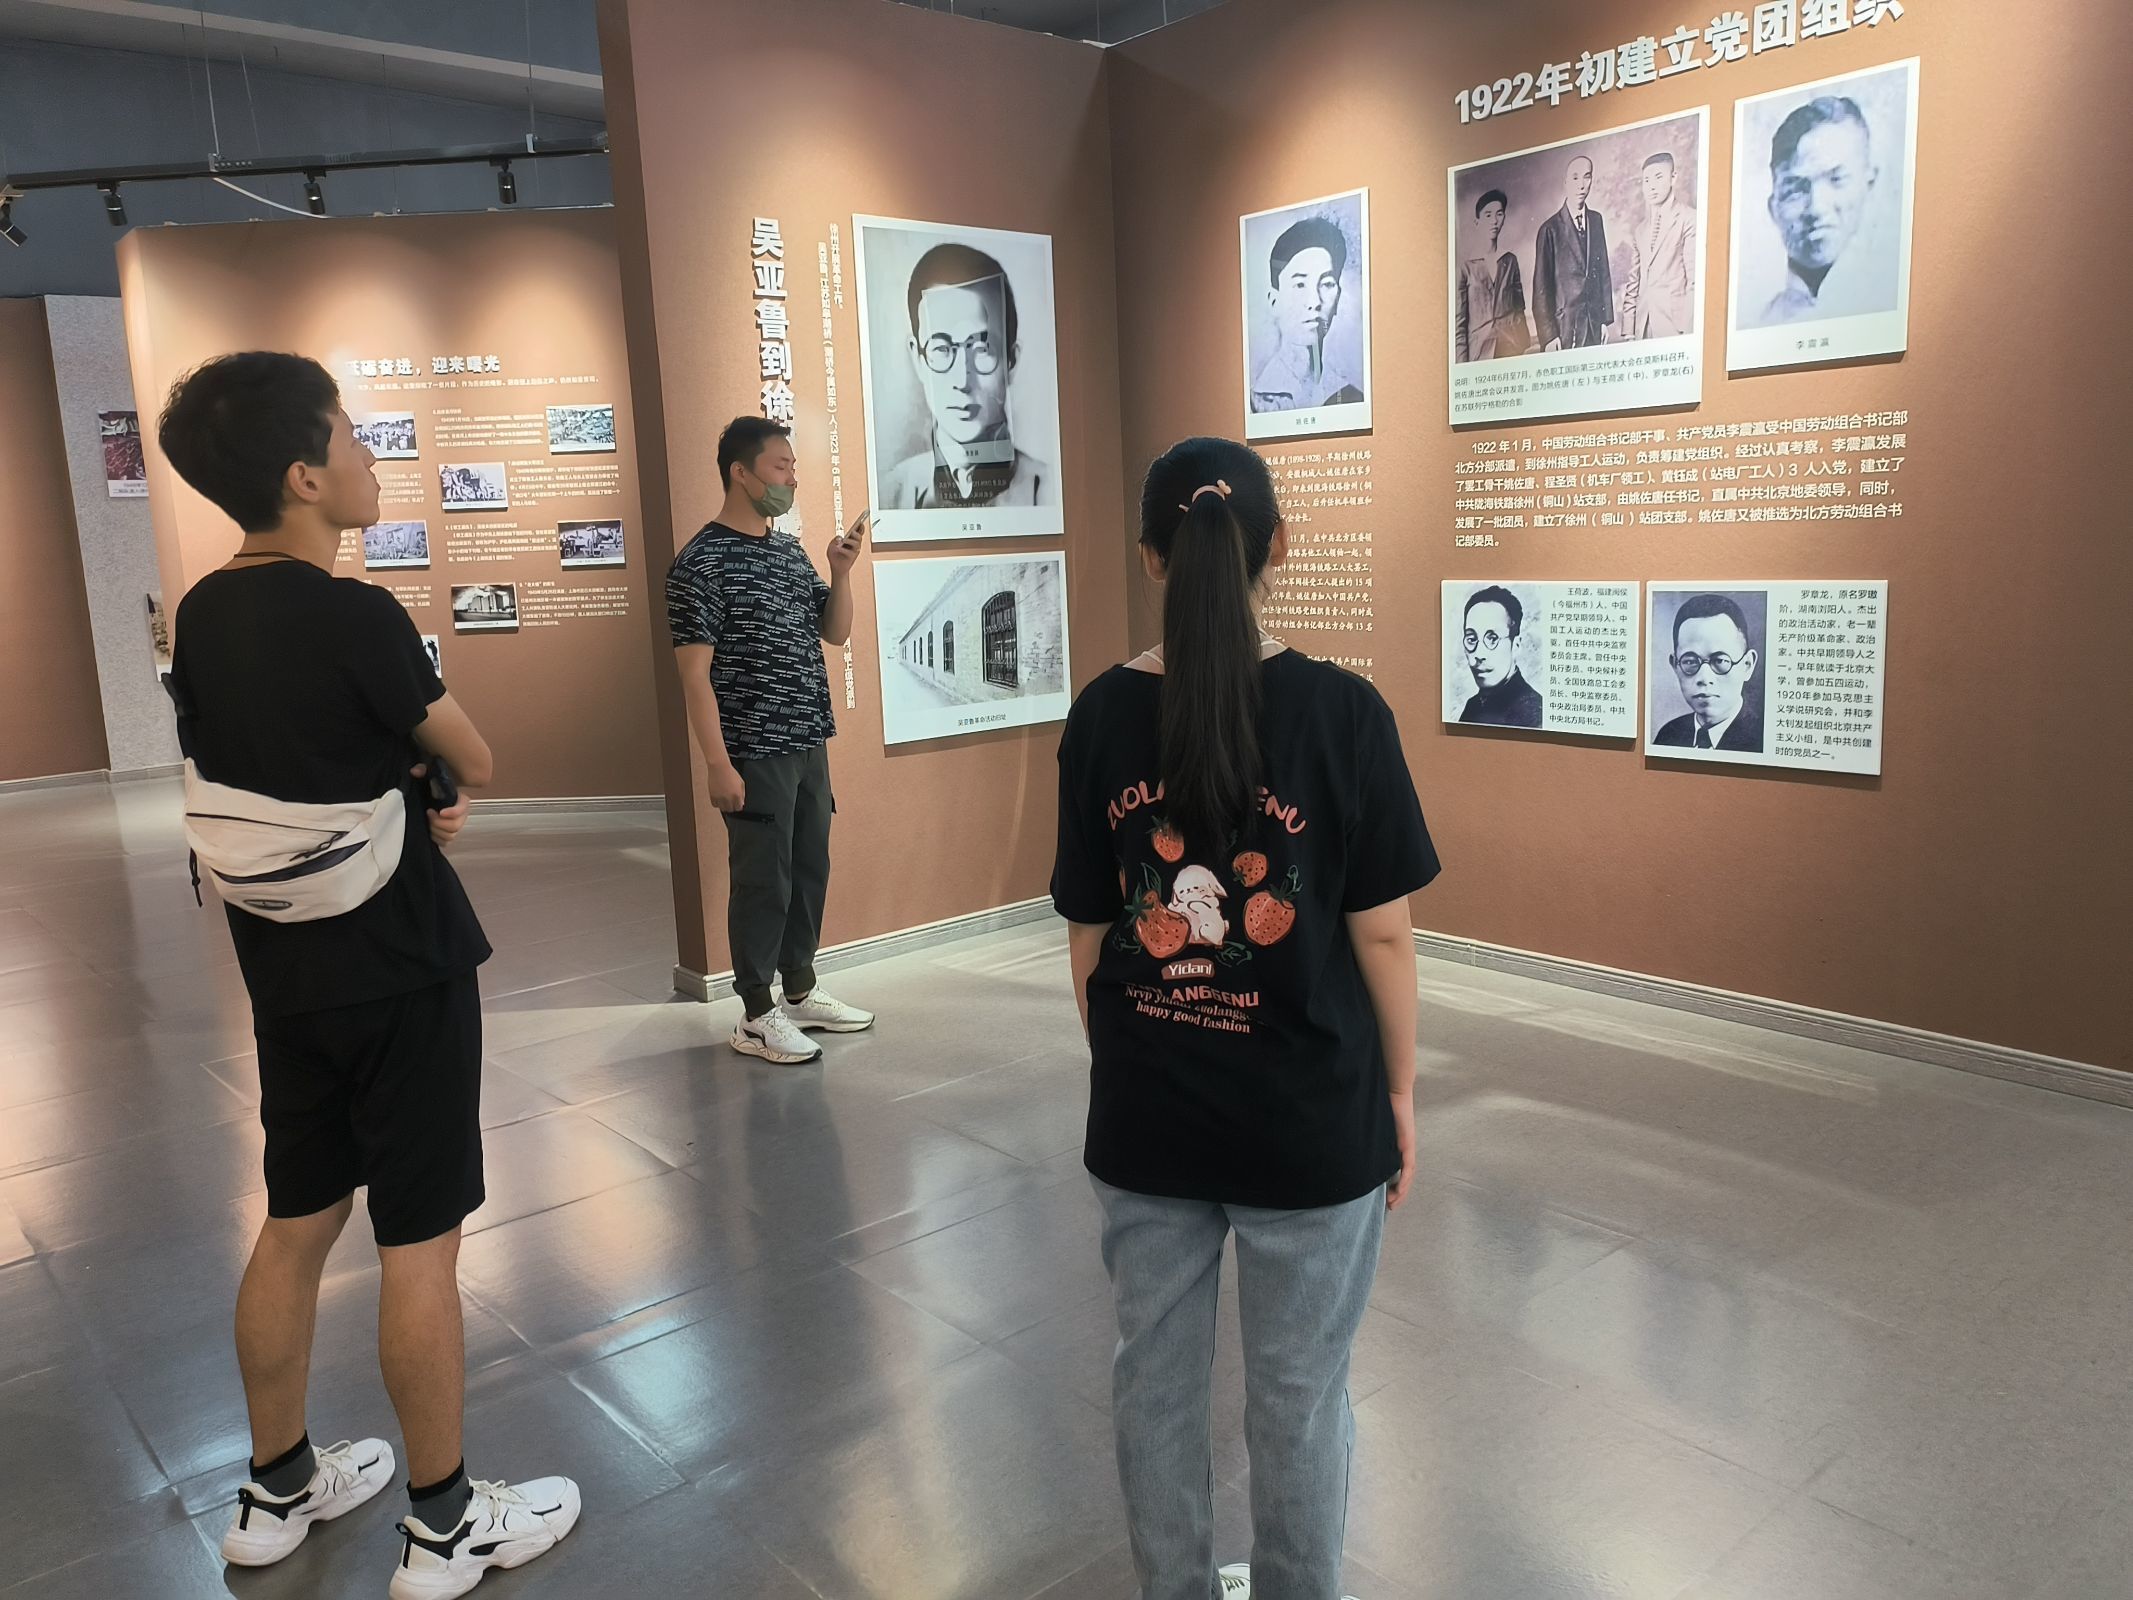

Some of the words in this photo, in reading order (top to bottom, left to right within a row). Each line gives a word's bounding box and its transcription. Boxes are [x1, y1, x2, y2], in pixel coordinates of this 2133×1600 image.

[1455, 0, 1905, 123] 1922年初建立党团组织
[1455, 535, 1499, 547] 记部委员。
[1777, 691, 1874, 704] 1920年参加马克思主
[1136, 1000, 1172, 1019] happy
[1173, 1010, 1201, 1026] good
[1202, 1017, 1251, 1034] fashion
